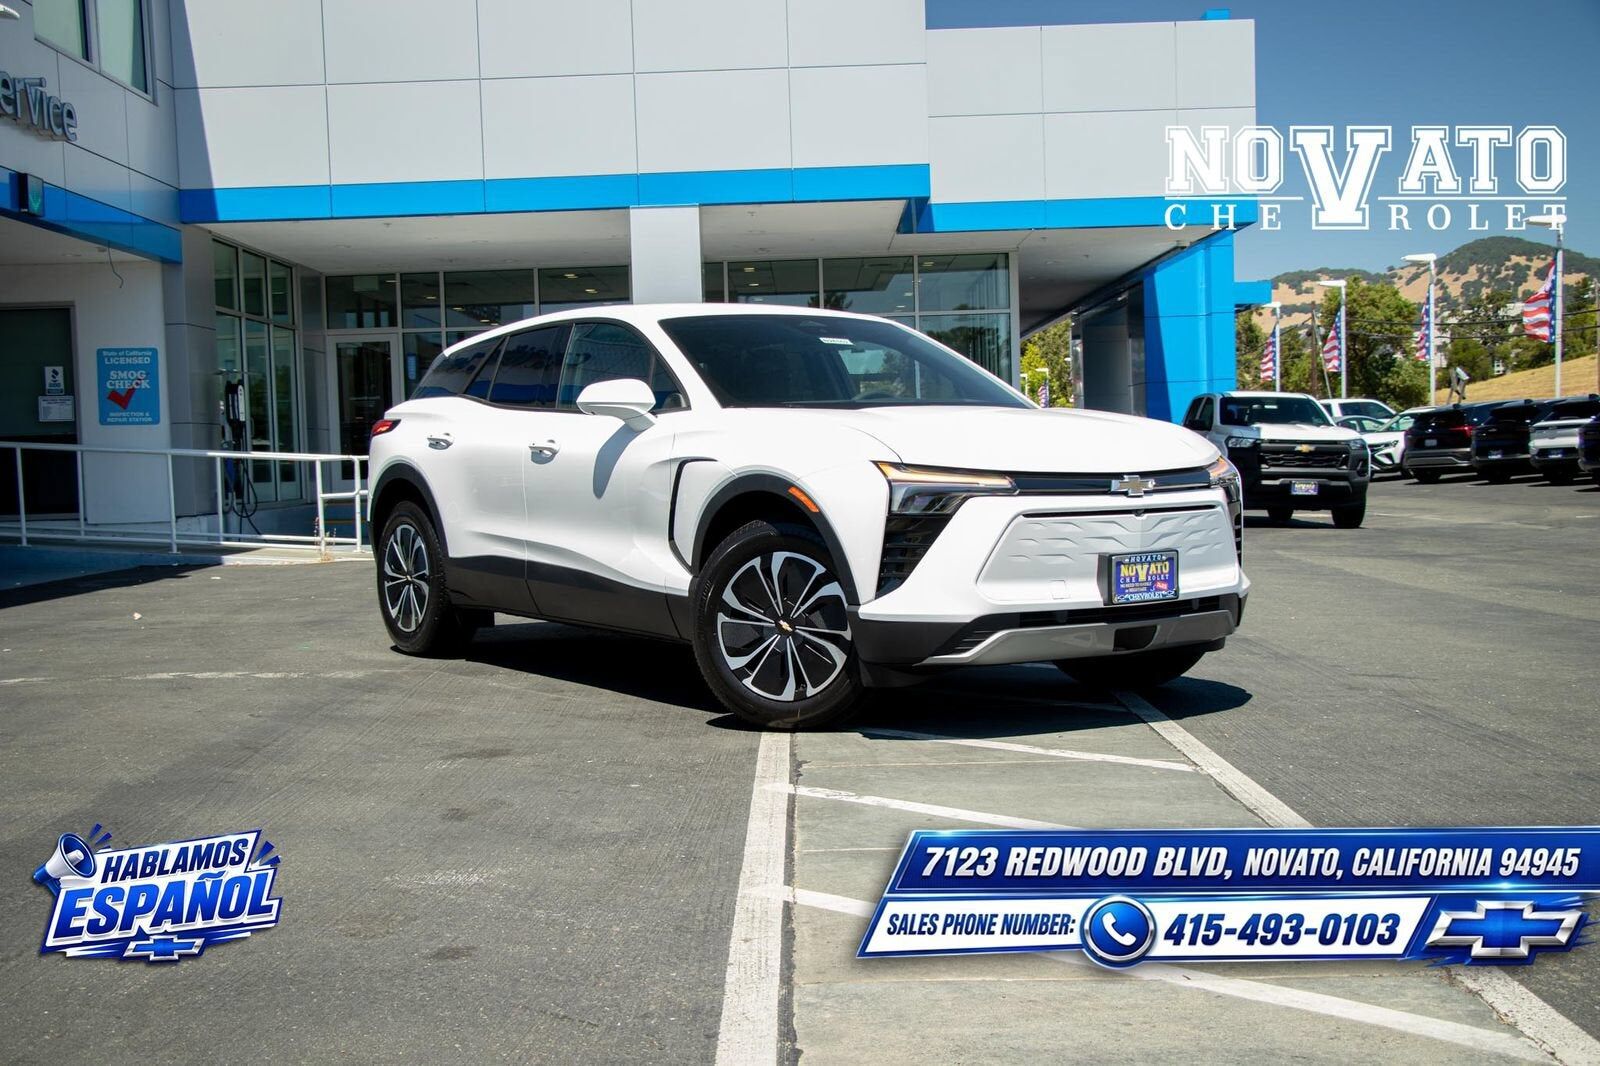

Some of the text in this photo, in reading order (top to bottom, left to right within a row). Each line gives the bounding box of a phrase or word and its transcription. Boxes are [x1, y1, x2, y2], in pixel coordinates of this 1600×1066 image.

[104, 357, 150, 365] LICENSED
[110, 370, 146, 380] SMOG
[106, 380, 151, 389] CHECK
[1120, 562, 1169, 582] NOVATO
[1128, 591, 1163, 600] CHEVROLET
